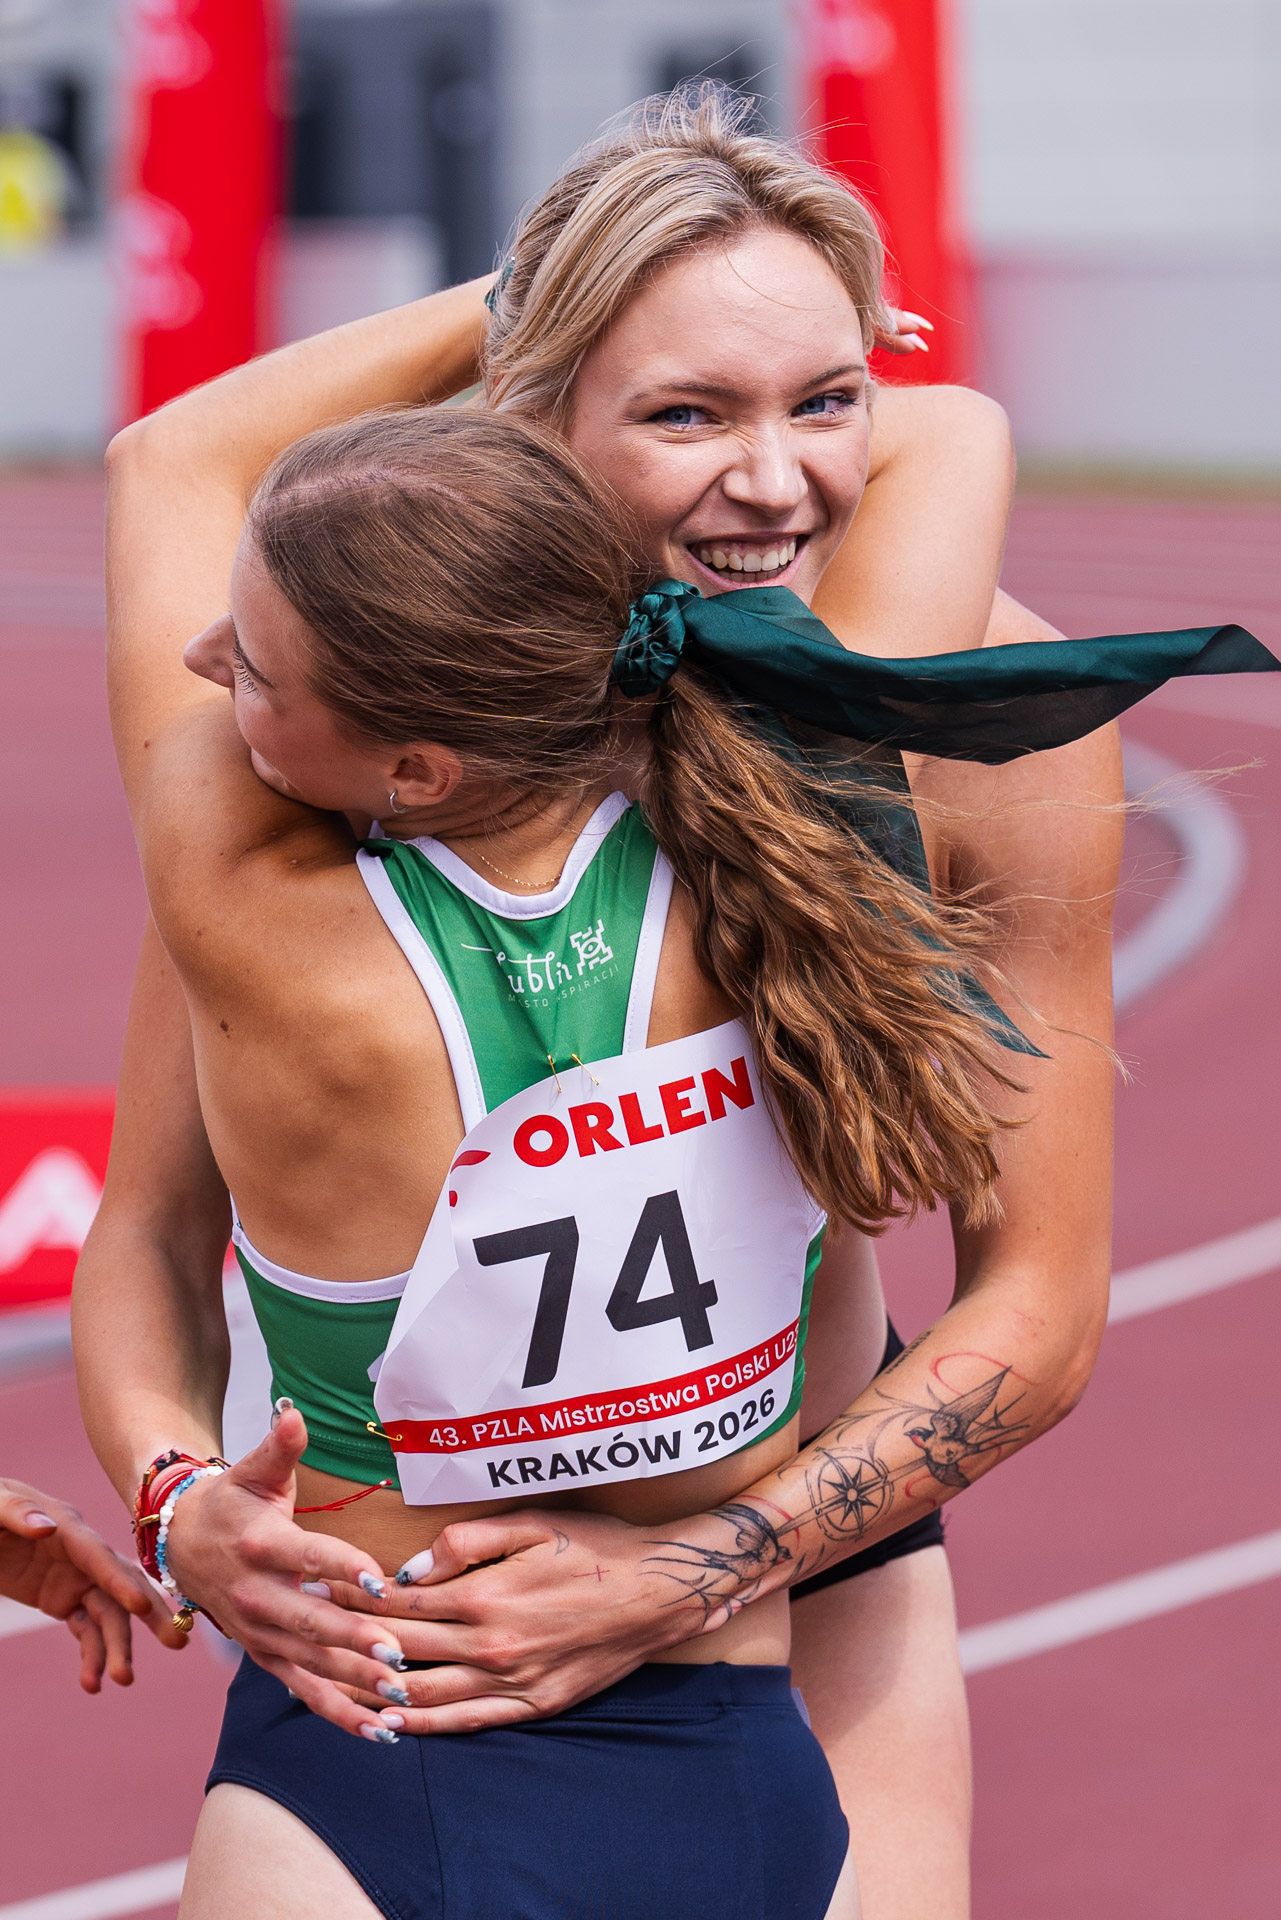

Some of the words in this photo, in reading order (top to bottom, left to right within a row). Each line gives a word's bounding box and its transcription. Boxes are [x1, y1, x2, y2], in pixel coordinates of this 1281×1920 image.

[508, 994, 549, 1008] MSTO
[513, 1056, 755, 1167] ORLEN
[473, 1190, 718, 1389] 74
[429, 1427, 467, 1446] 43.
[472, 1416, 535, 1442] PZLA
[539, 1384, 700, 1433] Mistrzostwa
[705, 1348, 770, 1396] Polski
[487, 1431, 681, 1488] KRAKÓW
[694, 1388, 775, 1452] 2026
